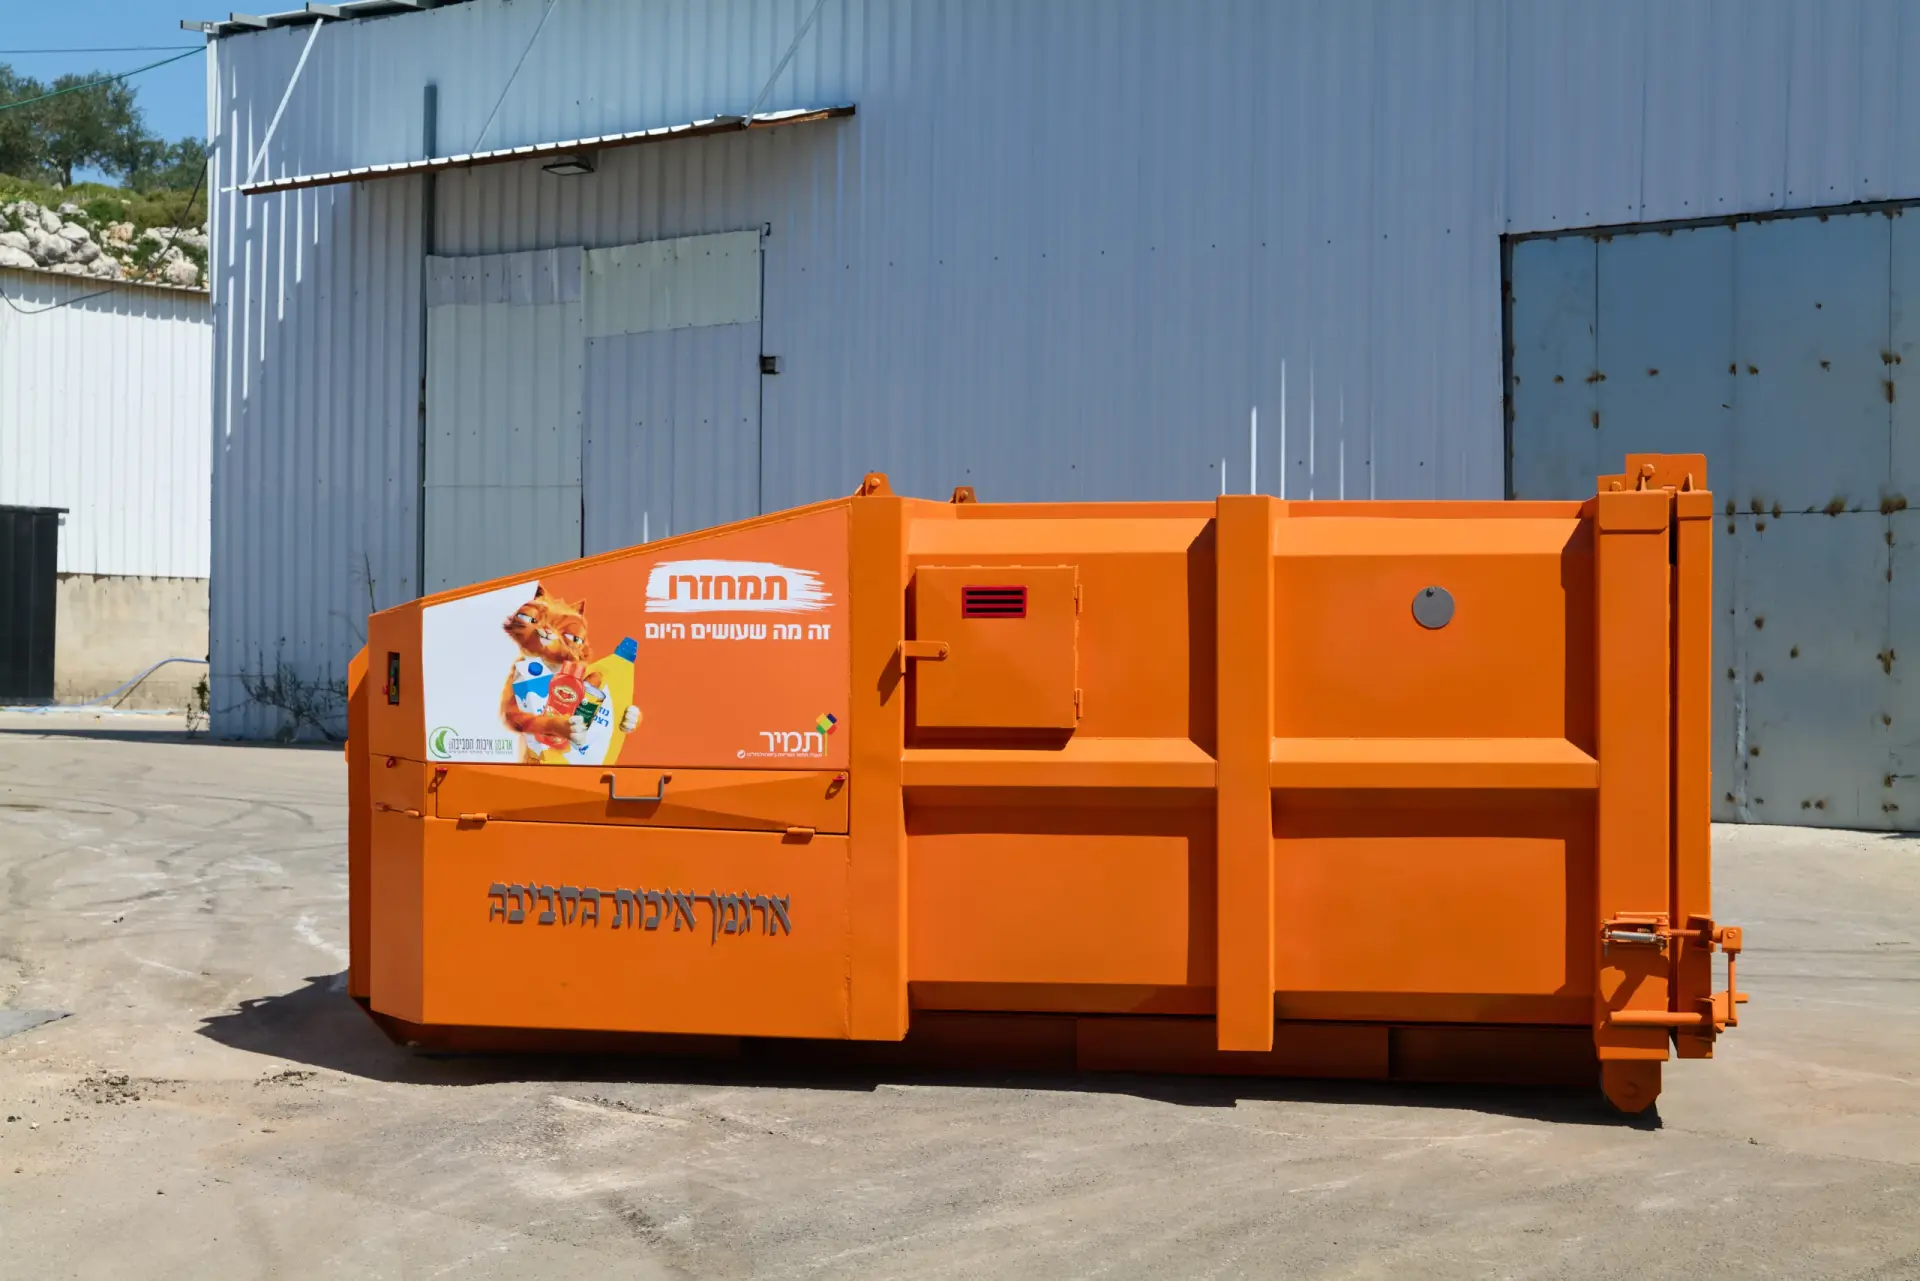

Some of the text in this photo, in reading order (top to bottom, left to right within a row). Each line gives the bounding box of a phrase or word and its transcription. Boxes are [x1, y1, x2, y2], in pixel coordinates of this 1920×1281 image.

[668, 575, 788, 601] תמחזרו
[644, 623, 831, 641] זה מה שעושים היום
[451, 738, 474, 750] הסביבה
[475, 738, 493, 750] איכות
[759, 731, 823, 753] תמיר
[488, 881, 792, 947] ארגמן איכות הסביבה
